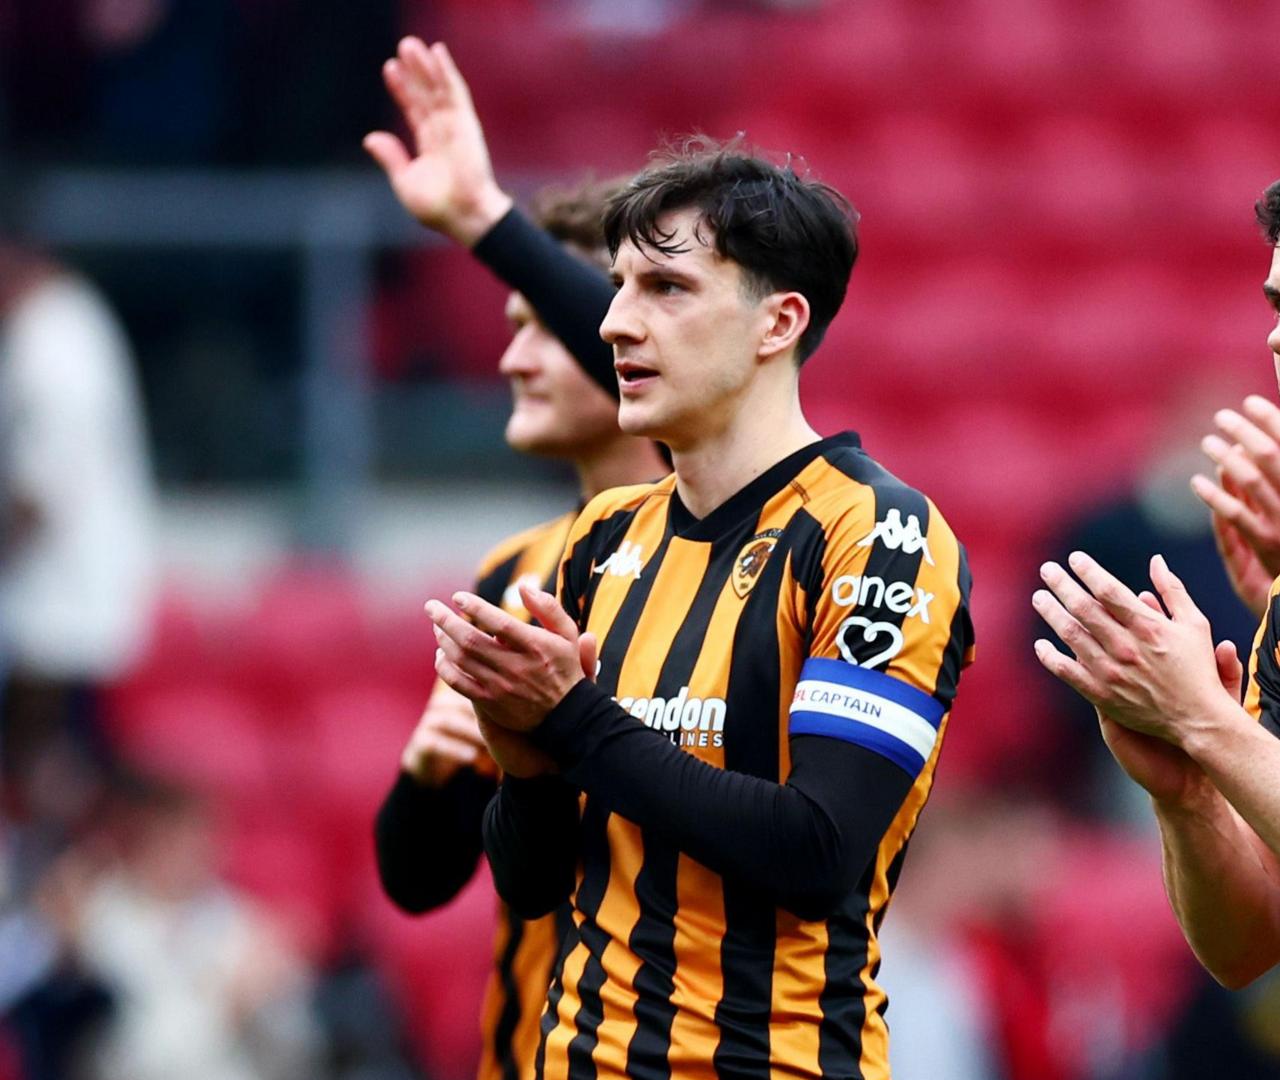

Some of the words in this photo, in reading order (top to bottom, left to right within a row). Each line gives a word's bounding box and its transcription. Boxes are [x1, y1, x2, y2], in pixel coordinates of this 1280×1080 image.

[832, 575, 935, 625] anex
[611, 686, 727, 731] rendon
[809, 689, 883, 718] CAPTAIN
